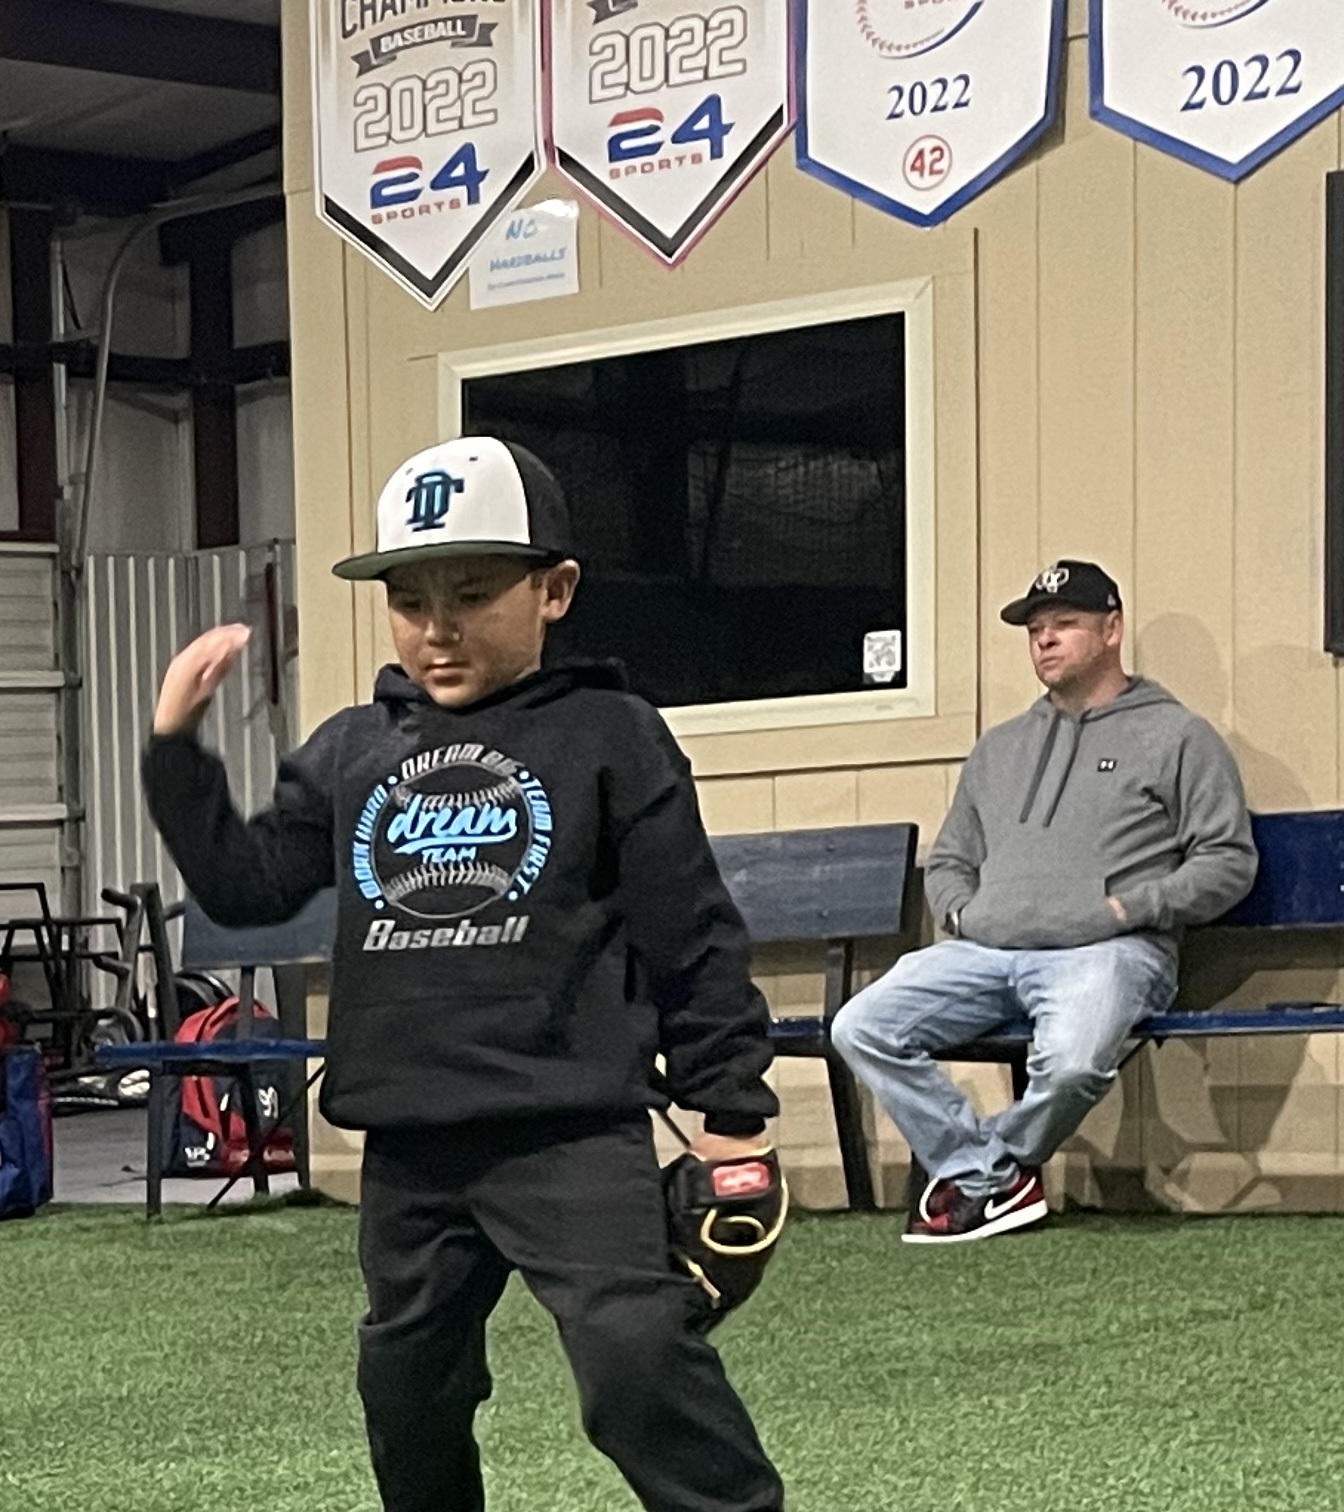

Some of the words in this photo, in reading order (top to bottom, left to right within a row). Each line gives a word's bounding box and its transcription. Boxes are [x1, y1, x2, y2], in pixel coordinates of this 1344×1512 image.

[379, 19, 466, 51] BASEBALL
[589, 5, 747, 104] 2022
[886, 74, 971, 120] 2022
[1180, 48, 1303, 113] 2022
[353, 57, 498, 153] 2022
[608, 93, 736, 163] 24
[370, 142, 490, 209] 24
[609, 153, 702, 179] SPORTS
[910, 145, 945, 178] 42
[371, 198, 460, 224] SPORTS
[506, 218, 538, 240] NO
[401, 743, 484, 779] DREAM
[387, 793, 517, 845] dream
[422, 847, 477, 864] TEAM
[515, 833, 552, 895] FIRST
[363, 915, 530, 951] Baseball
